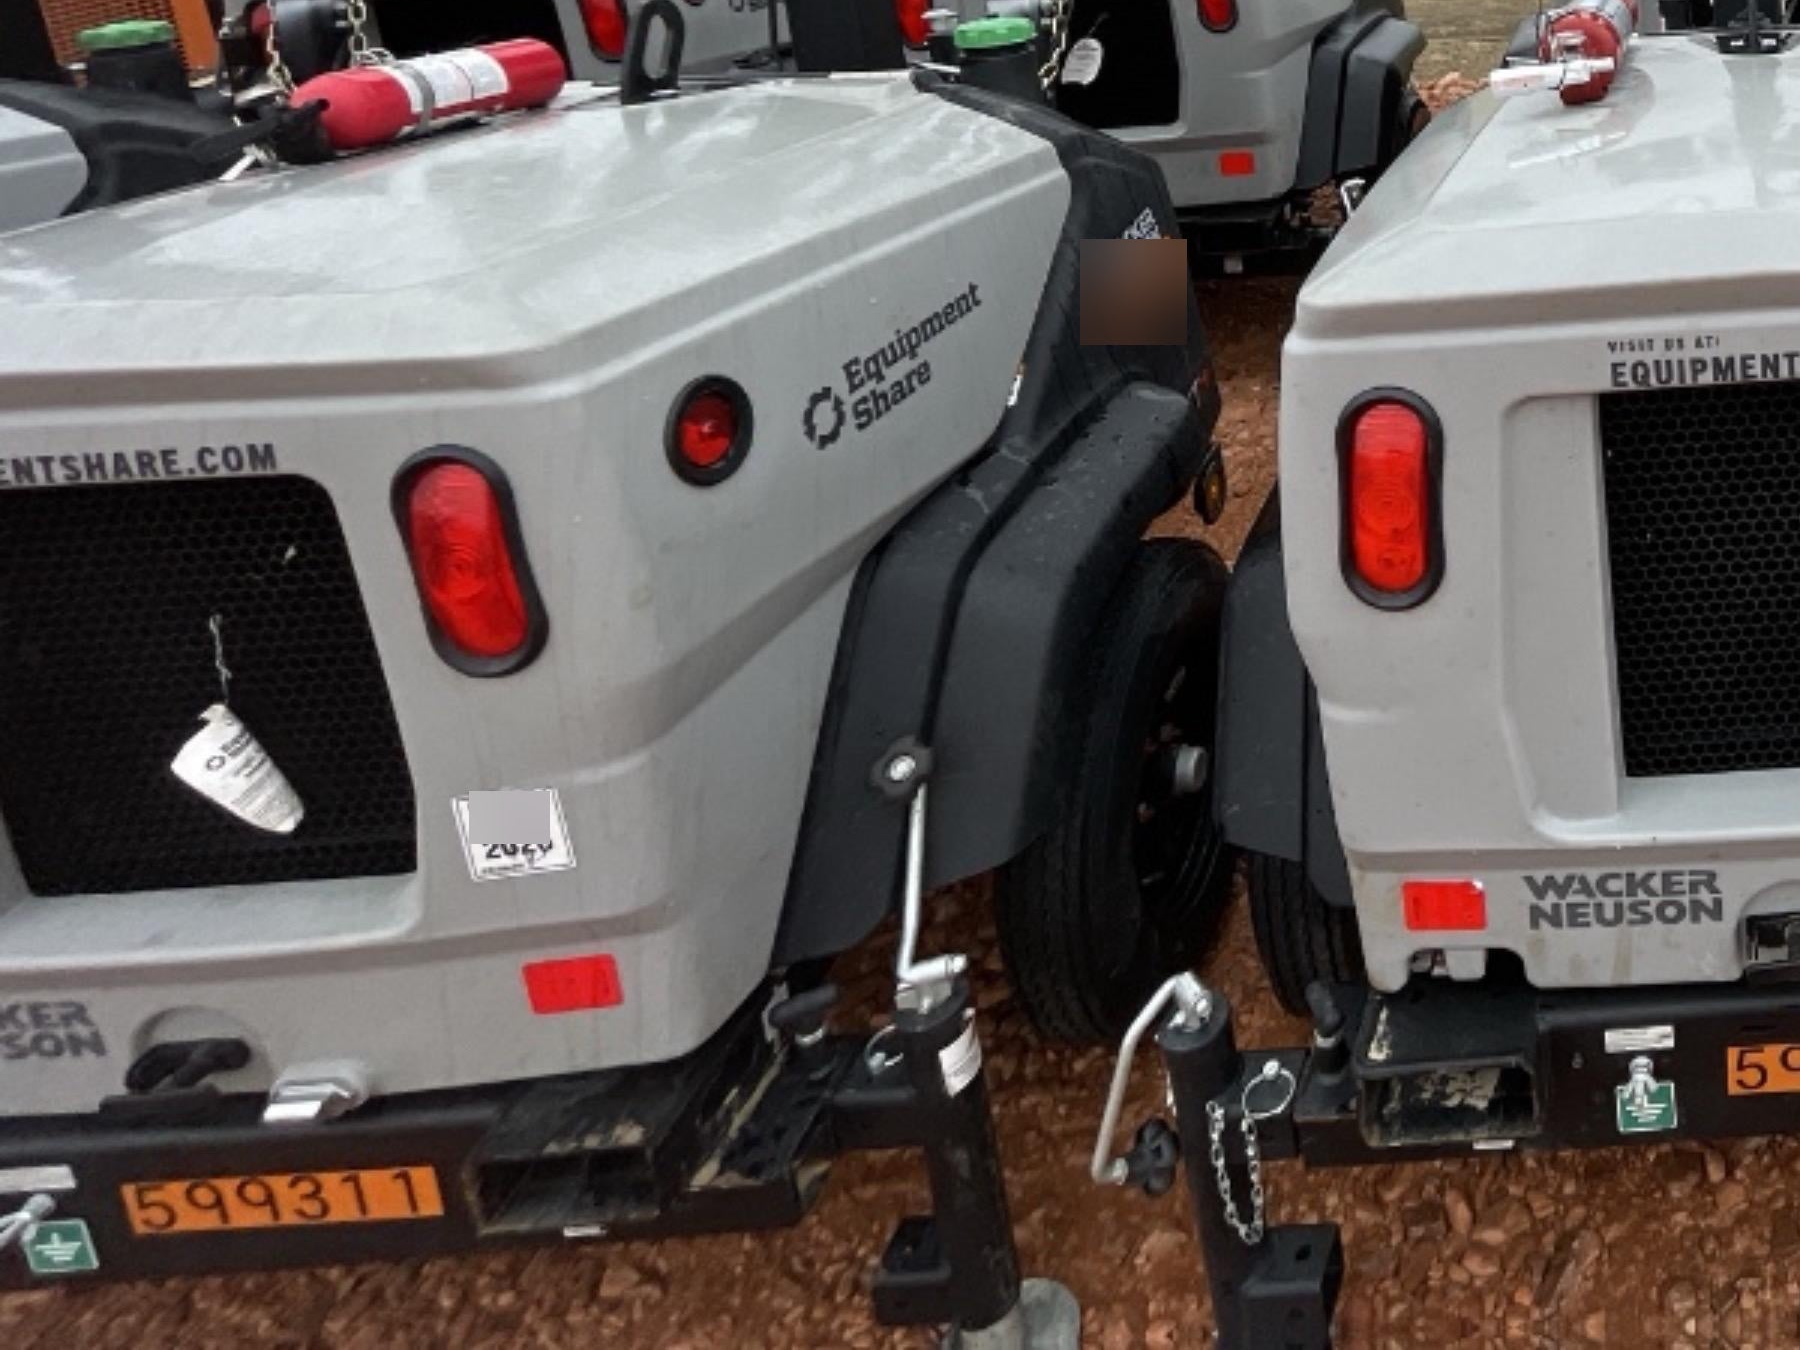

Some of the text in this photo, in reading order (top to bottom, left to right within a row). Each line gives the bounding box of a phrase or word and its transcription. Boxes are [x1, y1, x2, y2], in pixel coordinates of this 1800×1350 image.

[842, 282, 982, 394] Equipment
[852, 359, 932, 432] Share
[1521, 869, 1723, 901] WACKER
[1529, 896, 1723, 931] NEUSON
[135, 1168, 420, 1231] 599311
